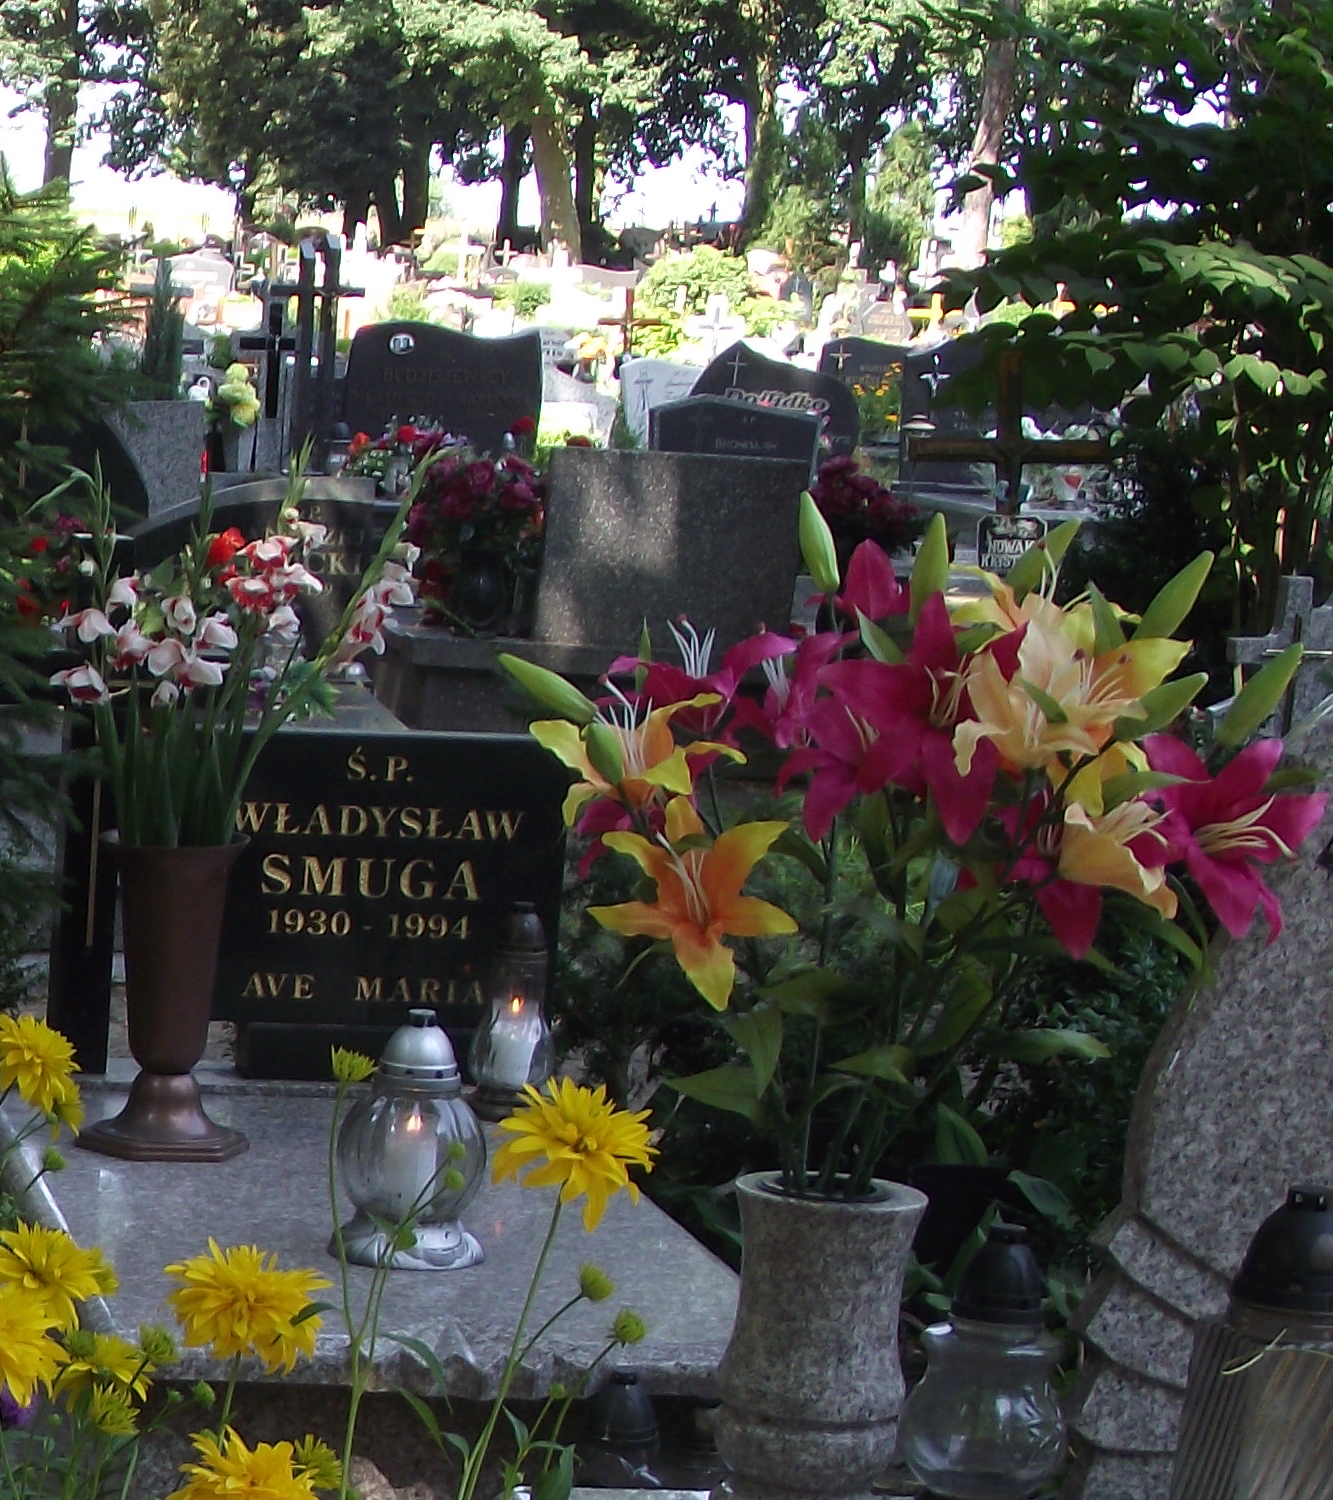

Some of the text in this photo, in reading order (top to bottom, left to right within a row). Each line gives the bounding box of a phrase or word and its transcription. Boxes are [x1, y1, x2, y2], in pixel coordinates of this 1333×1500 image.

[235, 801, 525, 841] WŁADYSŁAW
[261, 853, 482, 901] SMUGA
[268, 908, 352, 937] 1930
[388, 912, 472, 941] 1994
[242, 971, 485, 1005] AVE MARIA
